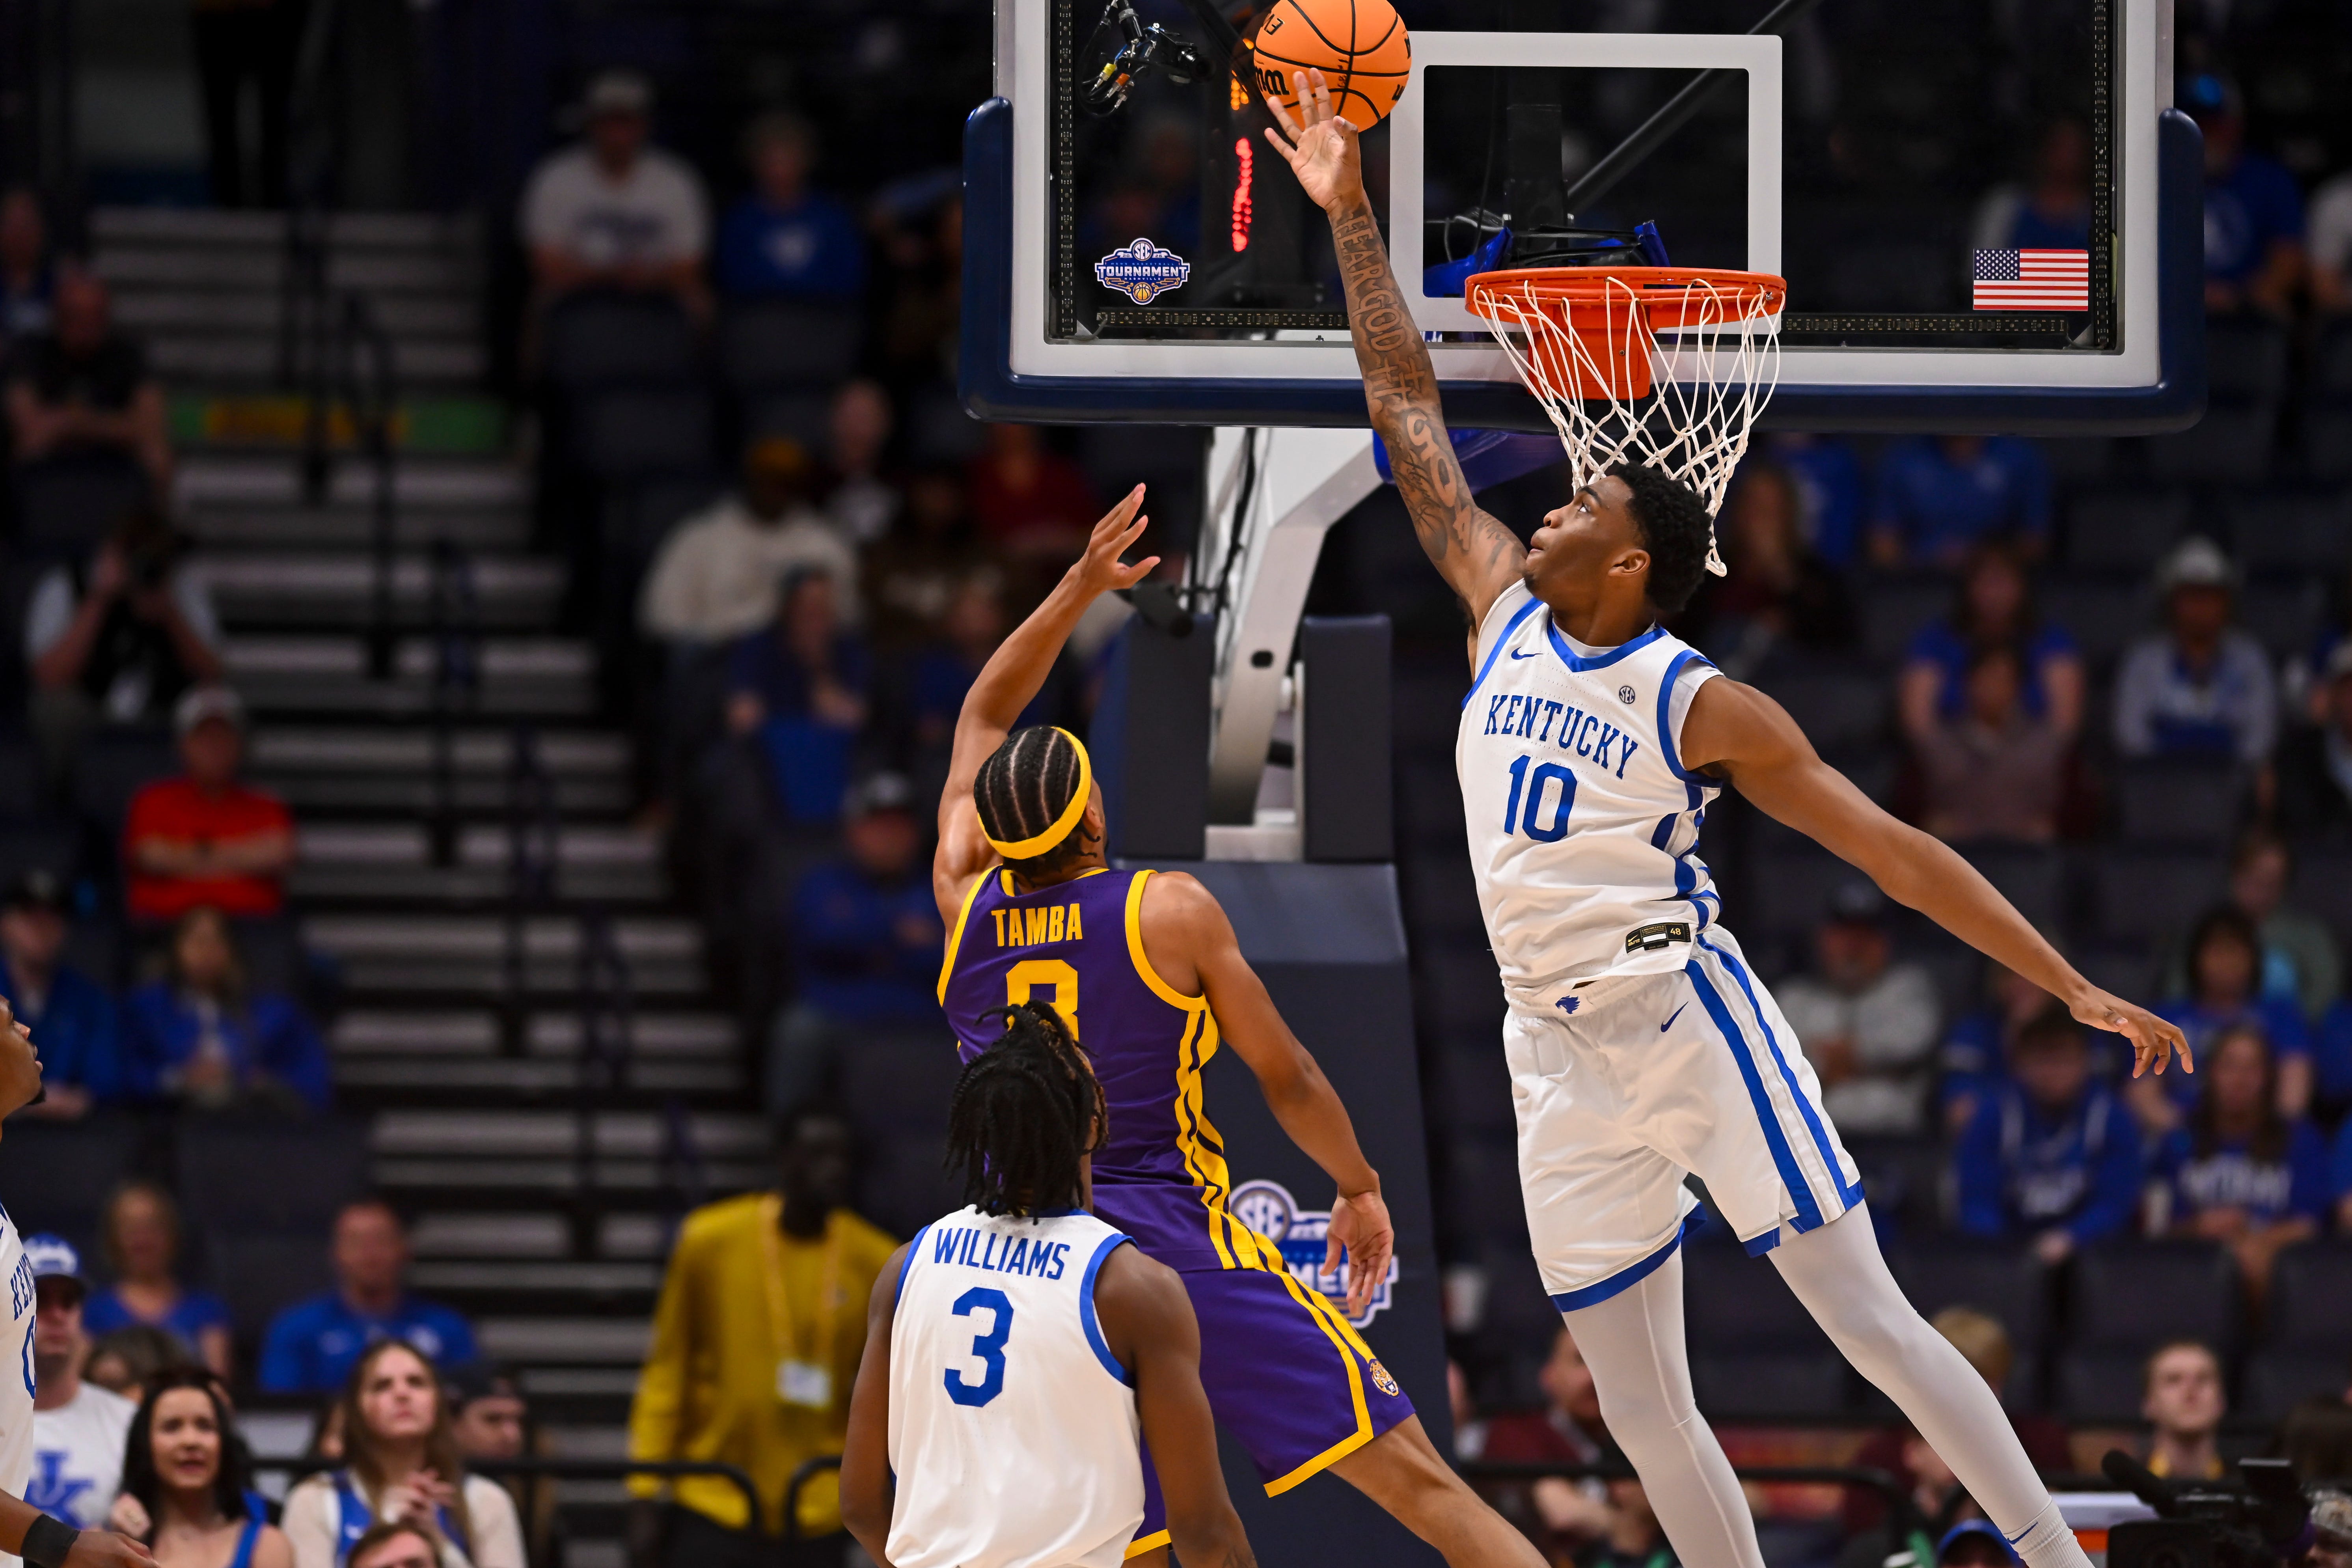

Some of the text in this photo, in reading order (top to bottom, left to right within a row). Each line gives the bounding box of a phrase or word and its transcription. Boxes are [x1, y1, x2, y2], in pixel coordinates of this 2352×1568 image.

[1098, 266, 1187, 278] TOURNAMENT
[1134, 243, 1150, 260] SEC
[1620, 686, 1634, 703] SEC
[1484, 694, 1638, 780] KENTUCKY
[1504, 754, 1578, 843] 10
[991, 903, 1083, 947] TAMBA
[934, 1227, 1071, 1280] WILLIAMS
[944, 1286, 1014, 1408] 3
